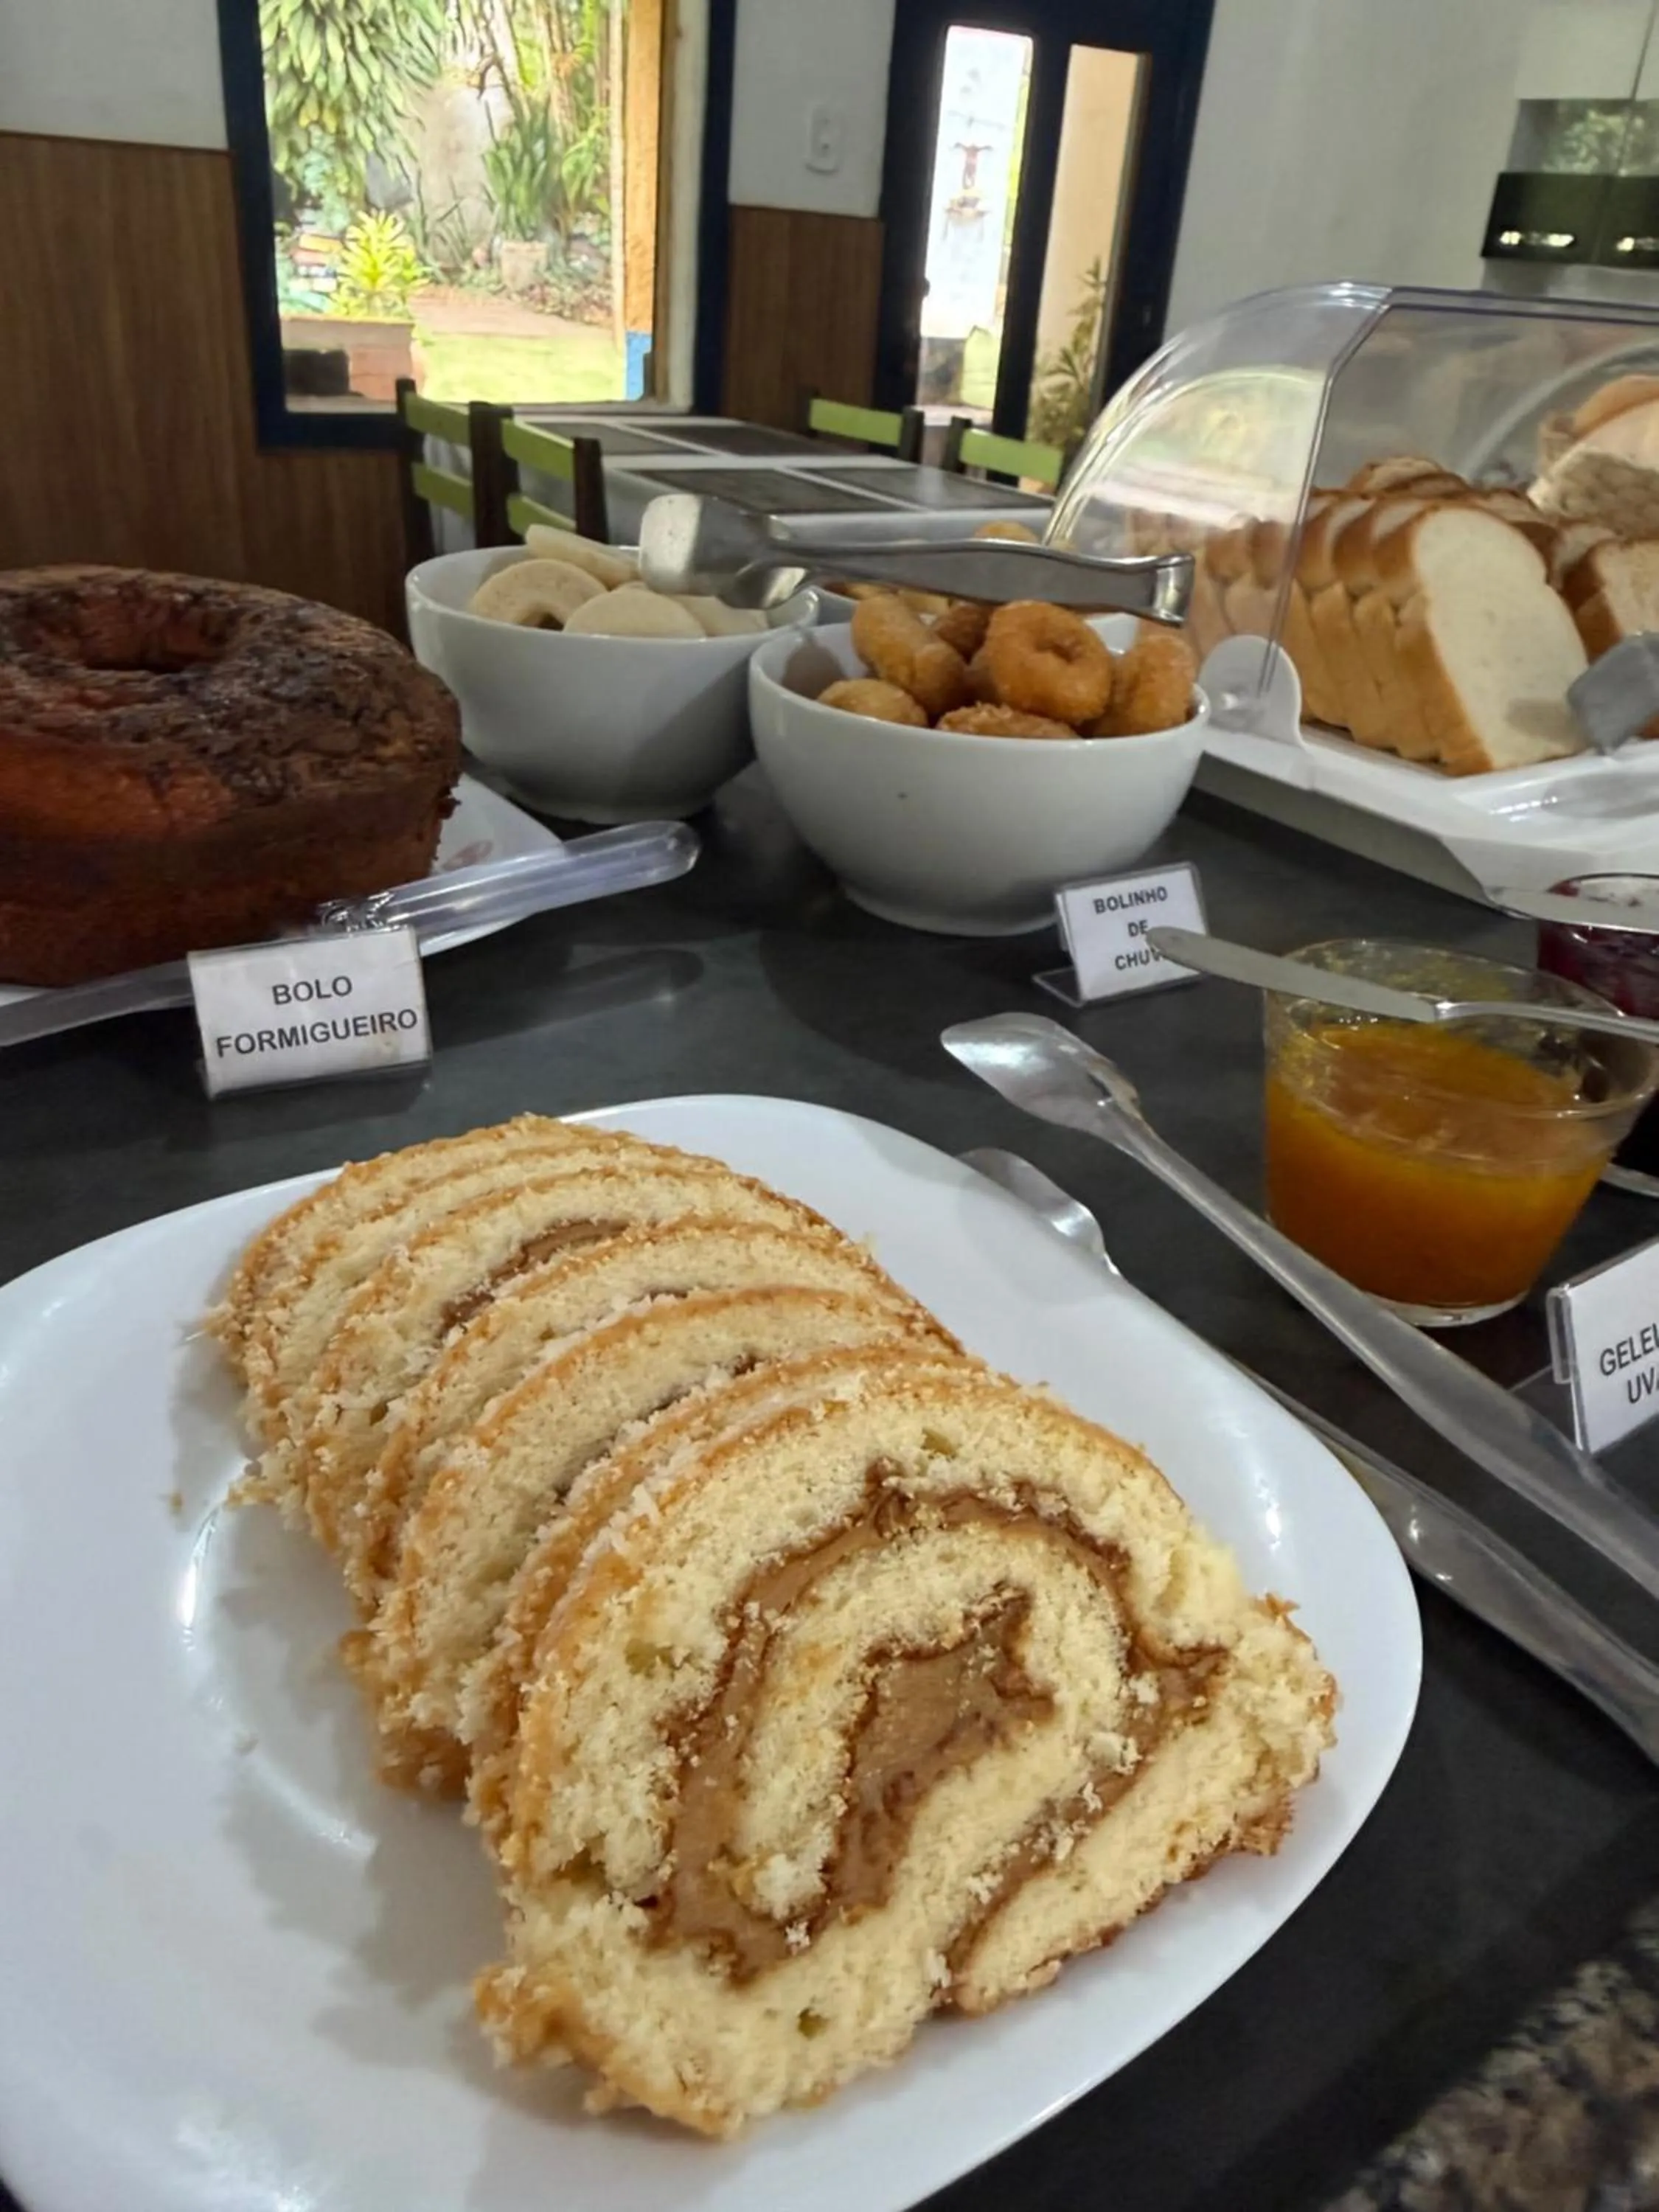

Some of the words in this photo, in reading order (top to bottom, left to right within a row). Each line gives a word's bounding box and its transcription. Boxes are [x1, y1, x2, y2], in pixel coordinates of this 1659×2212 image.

[1093, 886, 1168, 914] BOLINHO
[1128, 919, 1149, 937] DE
[1115, 947, 1161, 970] CHUV
[272, 975, 352, 1005] BOLO
[216, 1009, 417, 1057] FORMIGUEIRO
[1599, 1323, 1659, 1376] GELEI
[1627, 1367, 1659, 1404] UV
